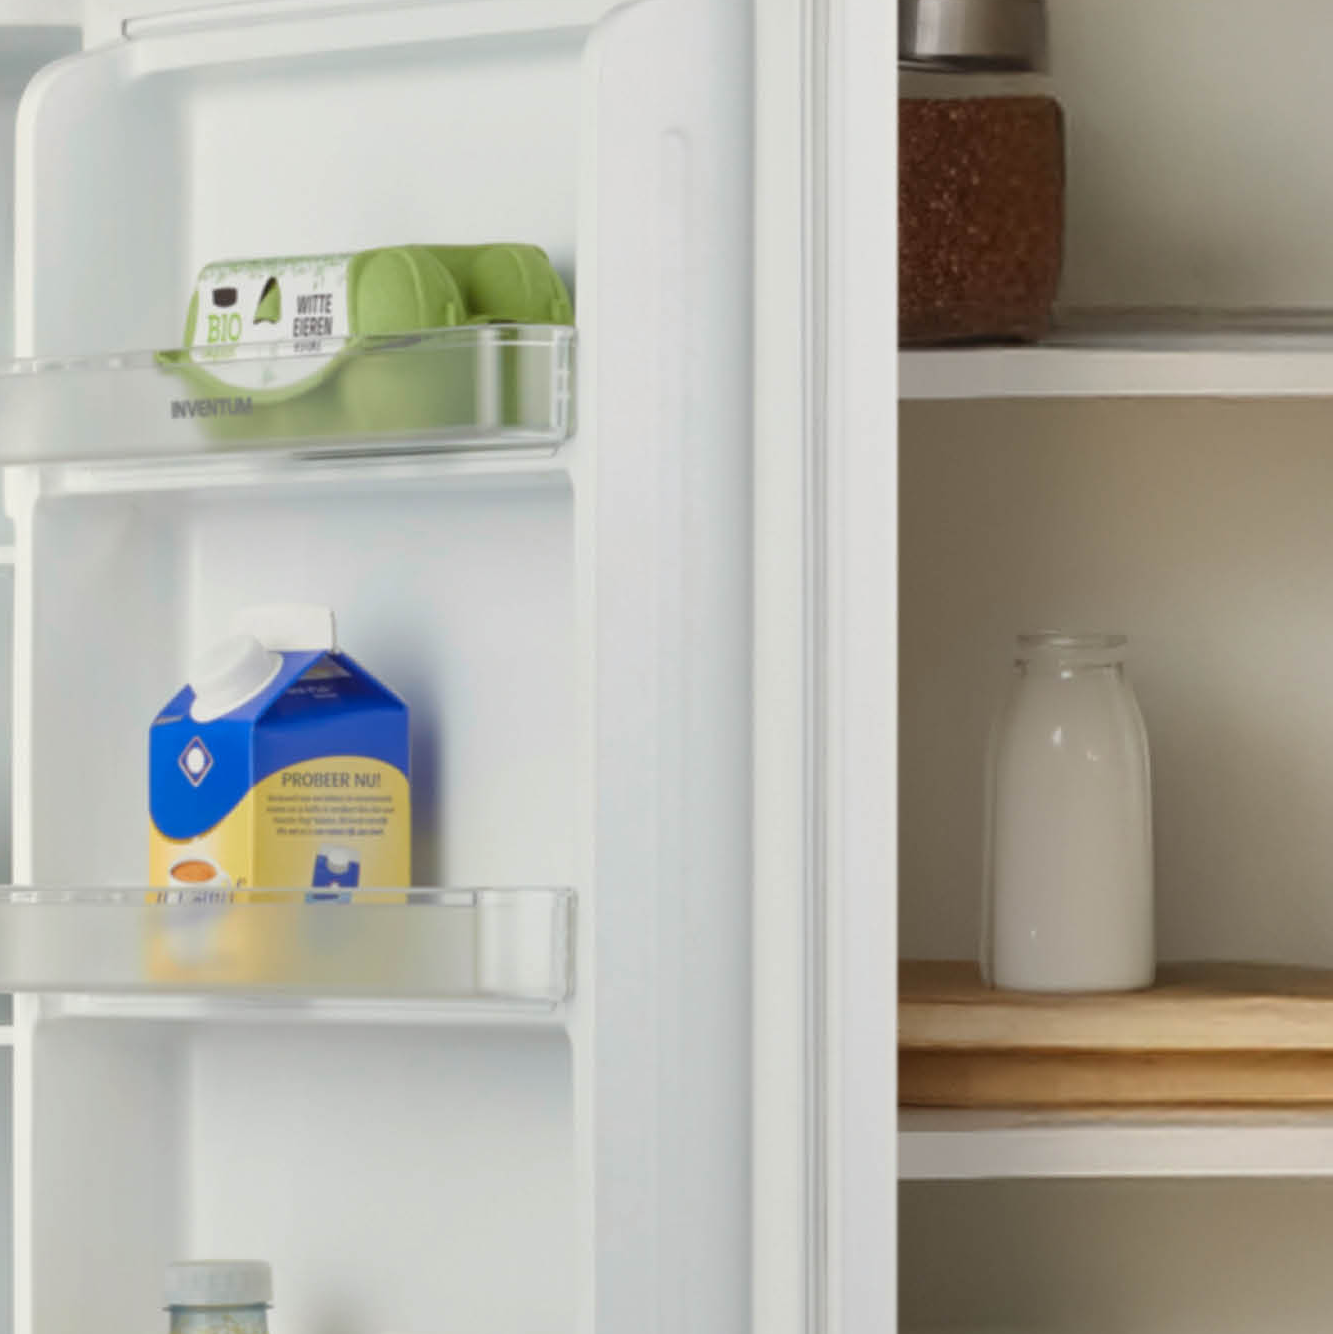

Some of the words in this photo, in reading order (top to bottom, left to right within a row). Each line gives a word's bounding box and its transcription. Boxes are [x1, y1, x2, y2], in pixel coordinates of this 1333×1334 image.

[296, 293, 333, 316] WITTE
[207, 313, 243, 344] BIO
[292, 316, 333, 338] EIEREN
[170, 396, 253, 419] INVENTUM
[281, 771, 350, 788] PROBEER
[354, 772, 382, 788] NU!
